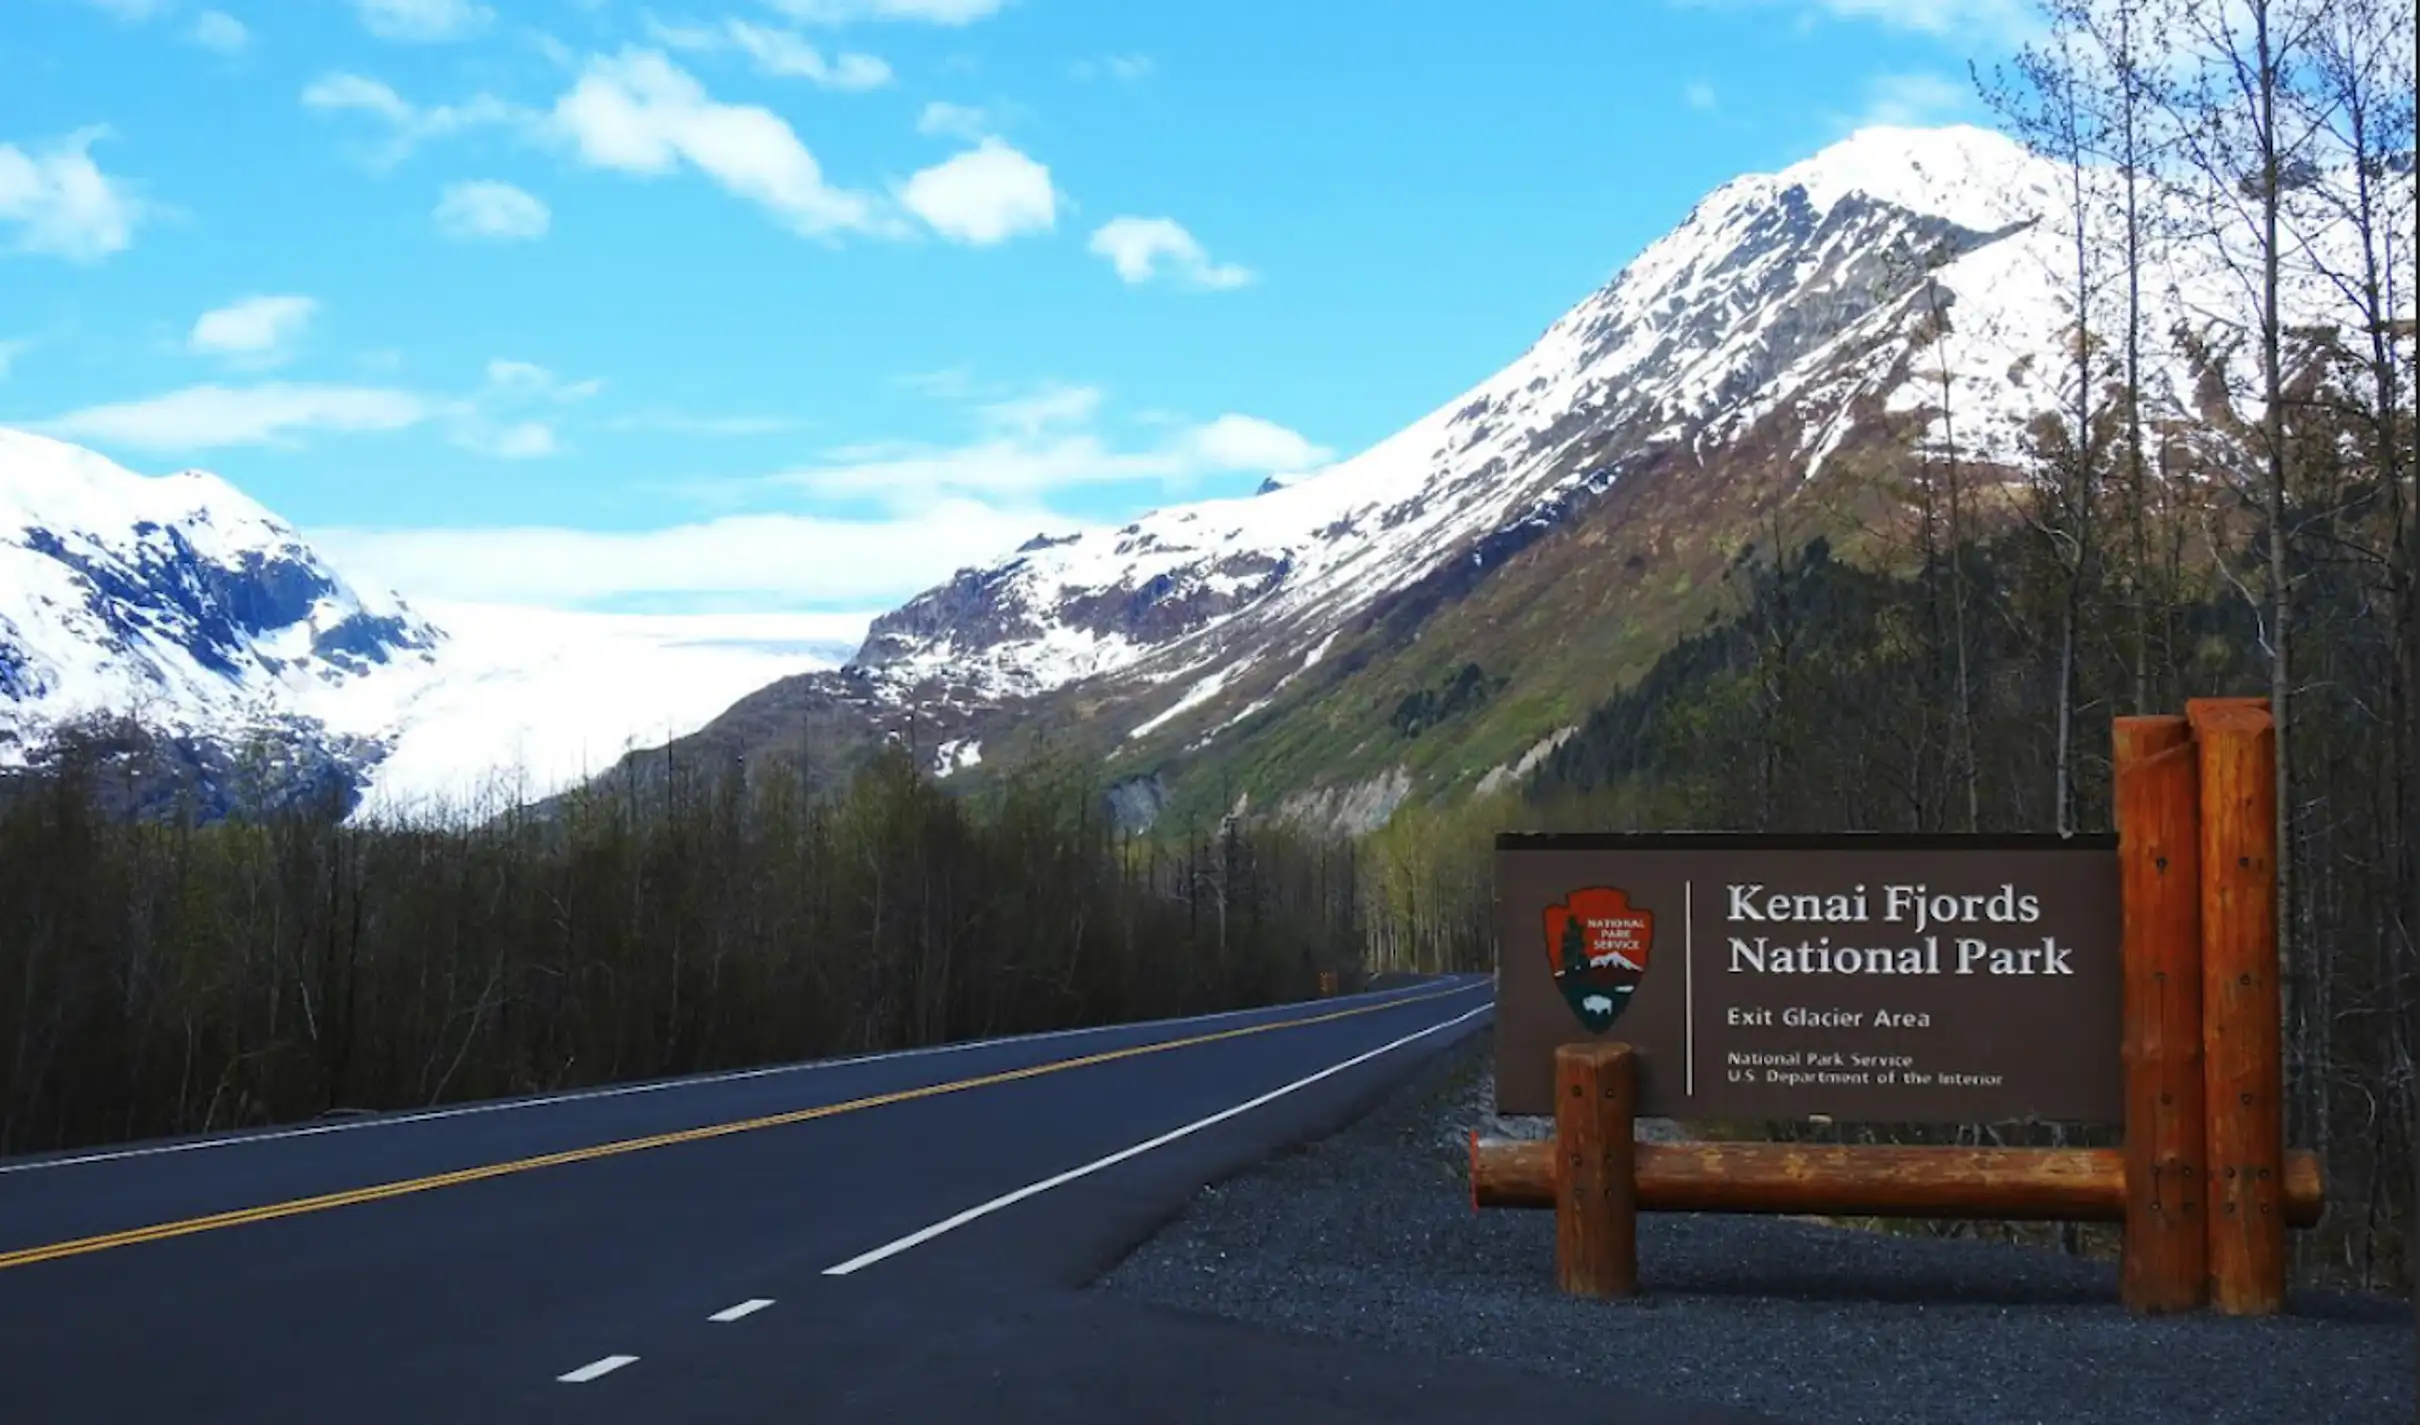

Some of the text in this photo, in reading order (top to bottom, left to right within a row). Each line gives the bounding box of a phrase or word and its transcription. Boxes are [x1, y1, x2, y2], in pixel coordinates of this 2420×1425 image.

[1726, 883, 2040, 933] Kenai Fjords
[1587, 918, 1645, 929] NATIONAL
[1600, 929, 1632, 939] PARK
[1593, 939, 1640, 951] SERVICE
[1727, 935, 2074, 975] National Park
[1727, 1007, 1931, 1028] Exit Glacier Area
[1727, 1051, 1914, 1068] National Park Service
[1766, 1069, 1870, 1087] Department
[1876, 1070, 1895, 1085] of
[1903, 1071, 1932, 1085] the
